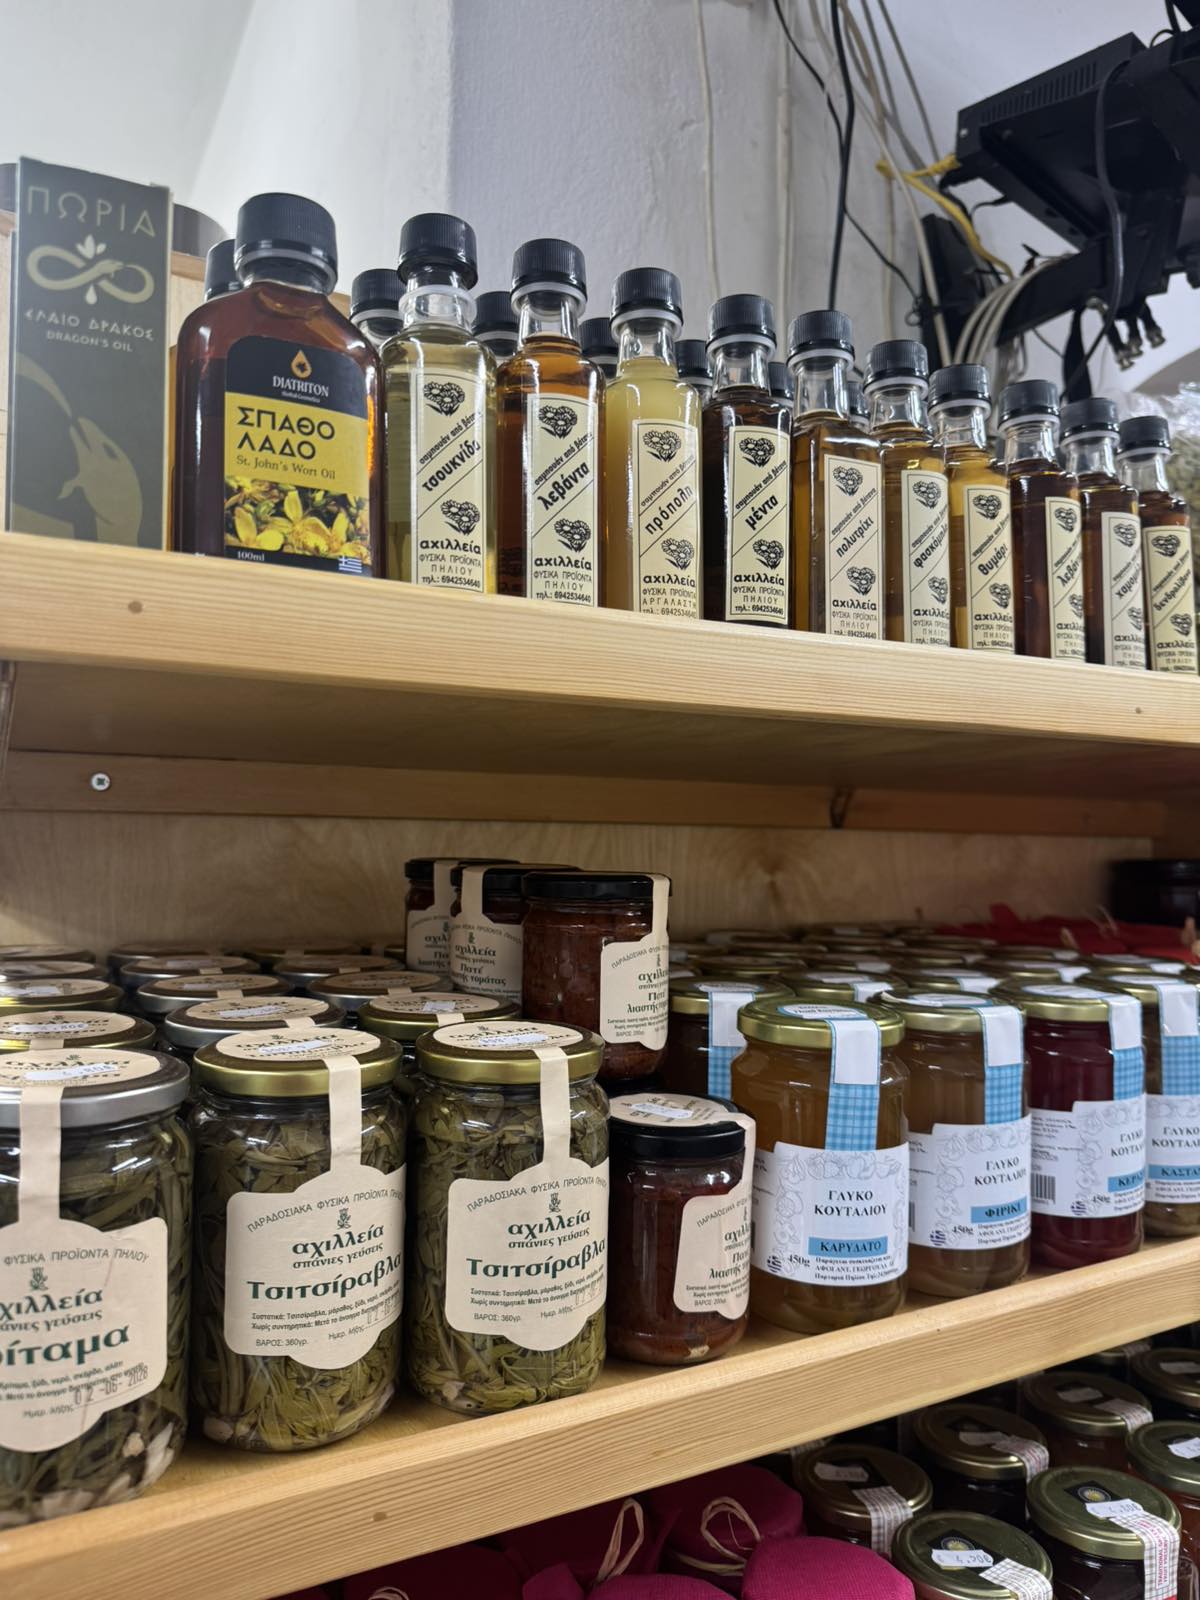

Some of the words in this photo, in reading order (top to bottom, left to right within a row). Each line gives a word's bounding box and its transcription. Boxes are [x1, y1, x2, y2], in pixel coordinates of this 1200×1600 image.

[27, 185, 155, 237] ΠΩΡΙΑ
[112, 340, 133, 352] OIL
[272, 375, 329, 398] DIATRITON
[236, 406, 336, 440] ΣΠΑΘΟ
[236, 431, 317, 461] ΛΑΔΟ
[236, 454, 251, 467] St.
[254, 456, 289, 473] John's
[292, 463, 318, 477] Wort
[321, 467, 336, 480] Oil
[537, 462, 590, 511] λεβάντα
[744, 495, 779, 532] μέντα
[836, 516, 874, 558] πολυτρίχι
[419, 538, 482, 555] αχιλλεία
[236, 550, 265, 562] 100ml
[419, 553, 446, 564] ΦΥΣΙΚΑ
[534, 555, 592, 571] αχιλλεία
[977, 543, 1008, 575] θυμάρι
[430, 563, 473, 577] ΠΗΛΙΟΥ
[533, 569, 559, 580] ΦΥΣΙΚΑ
[544, 581, 584, 592] ΠΗΛΙΟΥ
[642, 573, 696, 588] αχιλλεία
[733, 572, 785, 587] αχιλλεία
[733, 585, 757, 594] ΦΥΣΙΚΑ
[743, 594, 779, 605] ΠΗΛΙΟΥ
[832, 598, 877, 611] αχιλλεία
[839, 620, 871, 630] ΠΗΛΙΟΥ
[985, 1156, 1020, 1171] ΓΛΥΚΟ
[467, 1187, 527, 1212] ΠΑΡΑΔΟΣΙΑΚΑ
[530, 1180, 560, 1194] ΦΥΣΙΚΑ
[563, 1176, 595, 1188] ΠΡΟΪΟΝΤΑ
[828, 1189, 874, 1201] ΓΛΥΚΟ
[247, 1203, 313, 1233] ΠΑΡΑΔΟΣΙΑΚΑ
[316, 1194, 350, 1209] ΦΥΣΙΚΑ
[353, 1189, 389, 1203] ΠΡΟΪΟΝΤΑ
[813, 1203, 888, 1217] ΚΟΥΤΑΛΙΟΥ
[984, 1203, 1021, 1218] ΦΙΡΙΚΙ
[507, 1209, 591, 1240] αχιλλεία
[292, 1224, 385, 1259] αχιλλεία
[508, 1239, 555, 1250] σπάνιες
[557, 1227, 590, 1247] γεύσεις
[819, 1240, 882, 1253] ΚΑΡΥΔΑΤΟ
[4, 1252, 46, 1266] ΦΥΣΙΚΑ
[51, 1248, 110, 1262] ΠΡΟΪΟΝΤΑ
[113, 1247, 150, 1264] ΠΗΛΙΟΥ
[292, 1254, 344, 1270] σπάνιες
[347, 1242, 384, 1264] γεύσεις
[466, 1238, 606, 1279] Τσιτσίραβλα
[45, 1309, 103, 1332] γεύσεις
[255, 1339, 283, 1347] ΒΑΡΟΣ:
